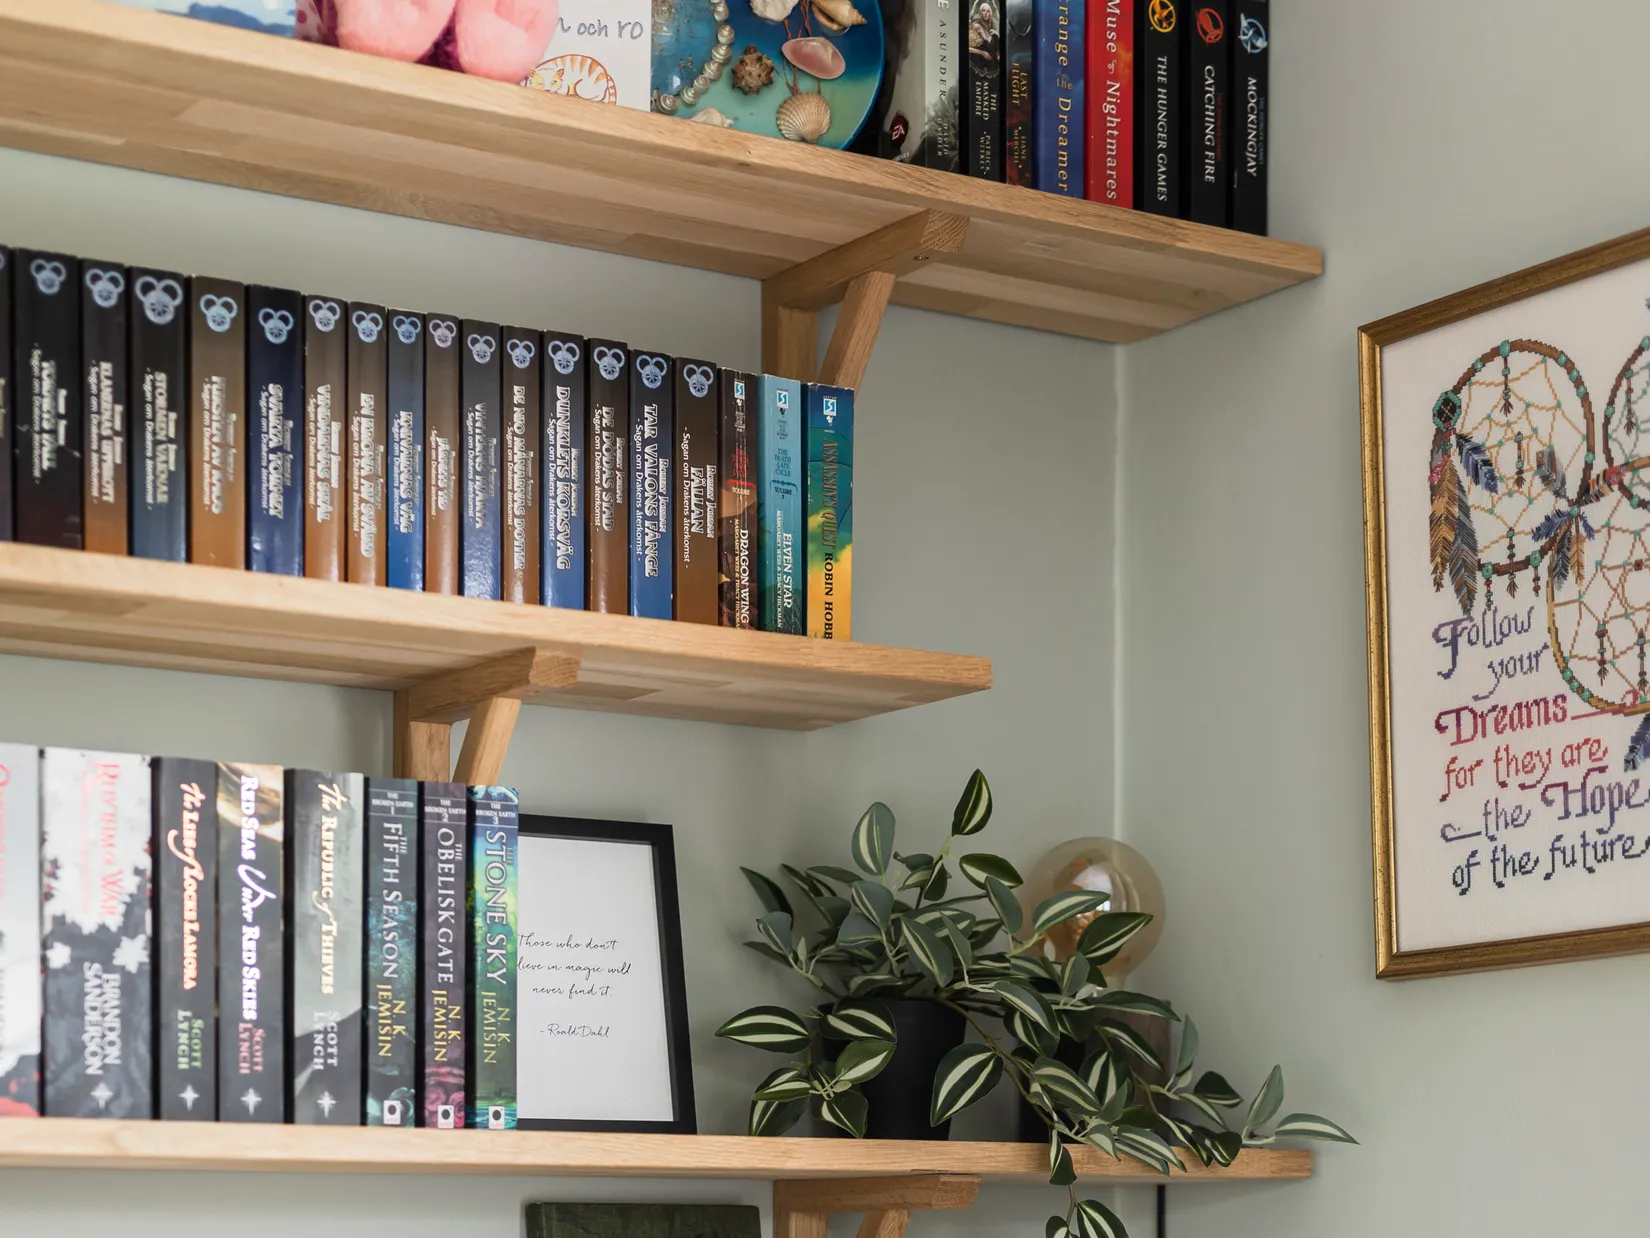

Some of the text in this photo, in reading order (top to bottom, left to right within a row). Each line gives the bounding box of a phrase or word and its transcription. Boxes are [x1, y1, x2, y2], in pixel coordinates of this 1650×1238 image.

[577, 19, 608, 38] och
[617, 20, 644, 40] ro
[939, 20, 947, 98] ASUNDER
[1055, 0, 1069, 67] range
[1020, 73, 1028, 99] LAST
[1103, 0, 1121, 200] Muse Nightmares
[1058, 97, 1072, 192] Dreamer
[1157, 56, 1167, 201] THE HUNGER GAMES
[1204, 65, 1215, 183] CATCHING FIRE
[1245, 77, 1257, 176] MOCKINGJAY
[268, 384, 283, 518] SVARTA TORNET
[547, 419, 556, 444] Sagan
[634, 425, 643, 451] Sagan
[636, 454, 641, 469] om
[360, 393, 376, 558] EN KRONA AV SVÄRD
[400, 411, 415, 533] KNIVARNAS VÄG
[513, 385, 527, 570] DE NIO MÅNARNAS DOTTER
[548, 463, 556, 496] Drakens
[556, 385, 573, 569] DUNKLETS KORSVÄG
[602, 406, 617, 531] DE DÖDAS STAD
[644, 404, 661, 577] TAR VALONS FÅNGE
[681, 433, 691, 562] Sagan om Drakens återkomst
[690, 467, 705, 534] FÄLLAN
[706, 465, 716, 538] ROBERT JORDAN
[822, 440, 838, 508] ASSASSIN'S
[548, 498, 556, 540] återkomst
[821, 511, 837, 549] QUEST
[740, 529, 749, 624] DRAGON WING
[783, 532, 792, 608] ELVEN STAR
[824, 552, 833, 640] ROBIN HOBB
[1432, 605, 1535, 680] Follow
[1472, 642, 1549, 701] your
[1434, 693, 1568, 746] Dreams
[180, 783, 205, 809] The
[1439, 737, 1608, 802] for they are
[92, 763, 121, 848] RHYTHM
[182, 810, 200, 847] LIES
[1483, 765, 1650, 842] the Hope
[399, 836, 407, 855] THE
[454, 843, 462, 861] THE
[1452, 831, 1650, 896] of the future
[100, 869, 123, 917] WAR
[183, 867, 200, 920] LOCKE
[237, 776, 276, 1020] RED SEAS Under RED SKIES
[312, 783, 348, 995] The REPUBLIC of THIEVES
[381, 822, 403, 979] FIFTH SEASON
[437, 827, 454, 983] OBELISK GATE
[484, 830, 507, 985] STONE SKY
[182, 922, 200, 989] LAMORA
[517, 932, 620, 950] Those who don't
[517, 956, 543, 971] lieve
[565, 966, 604, 980] magic
[607, 962, 631, 975] will
[82, 962, 102, 1075] SANDERSON
[101, 973, 122, 1064] BRANDON
[377, 984, 392, 1056] JEMISIN
[392, 1000, 406, 1040] N. K.
[448, 1005, 461, 1044] N. K.
[532, 984, 612, 999] never find it.
[177, 1010, 192, 1070] LYNCH
[191, 1018, 204, 1069] SCOTT
[239, 1022, 253, 1074] LYNCH
[252, 1028, 265, 1073] SCOTT
[312, 1011, 325, 1070] LYNCH
[325, 1011, 339, 1066] SCOTT
[431, 990, 448, 1062] JEMISIN
[481, 991, 496, 1064] JEMISIN
[497, 1007, 511, 1046] N. K.
[548, 1023, 610, 1037] Roald Dahl
